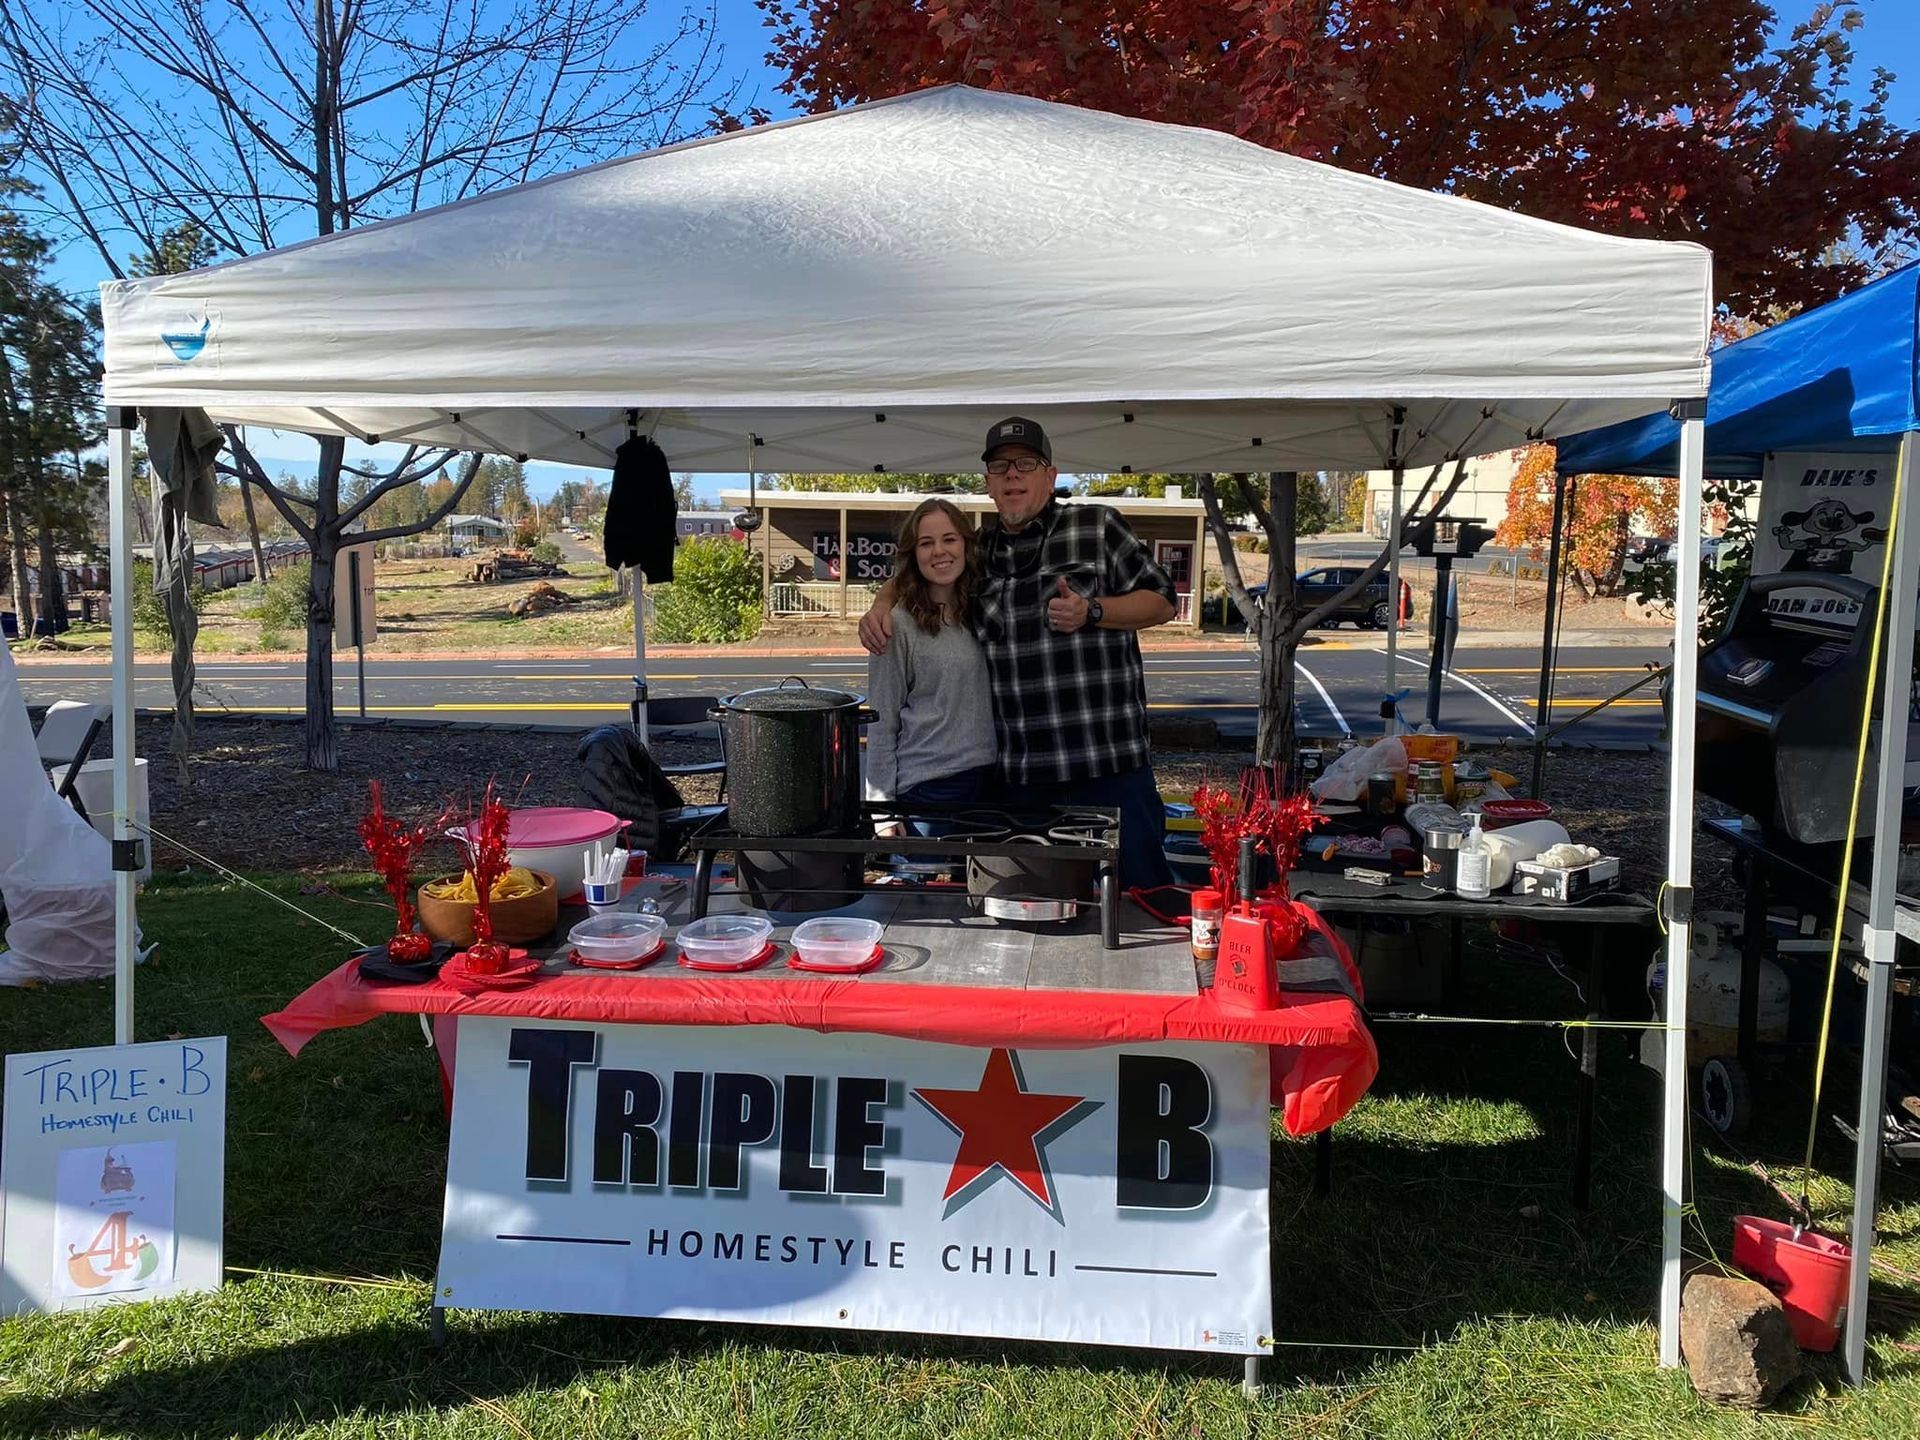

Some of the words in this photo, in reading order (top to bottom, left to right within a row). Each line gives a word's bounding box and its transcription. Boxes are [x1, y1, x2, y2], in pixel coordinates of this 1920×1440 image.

[1800, 469, 1878, 487] DAVE'S
[812, 536, 857, 556] HAR,
[857, 559, 895, 578] SOU
[1229, 941, 1252, 954] BEER
[1218, 978, 1257, 995] O'CLOCK
[23, 1057, 150, 1105] TRIPLE
[177, 1045, 211, 1096] B
[41, 1111, 138, 1135] HOMESTYLE
[147, 1105, 194, 1124] CHILI
[508, 1028, 890, 1197] TRIPLE
[1116, 1053, 1214, 1211] B
[646, 1227, 906, 1270] HOMESTYLE
[941, 1244, 1057, 1279] CHILI
